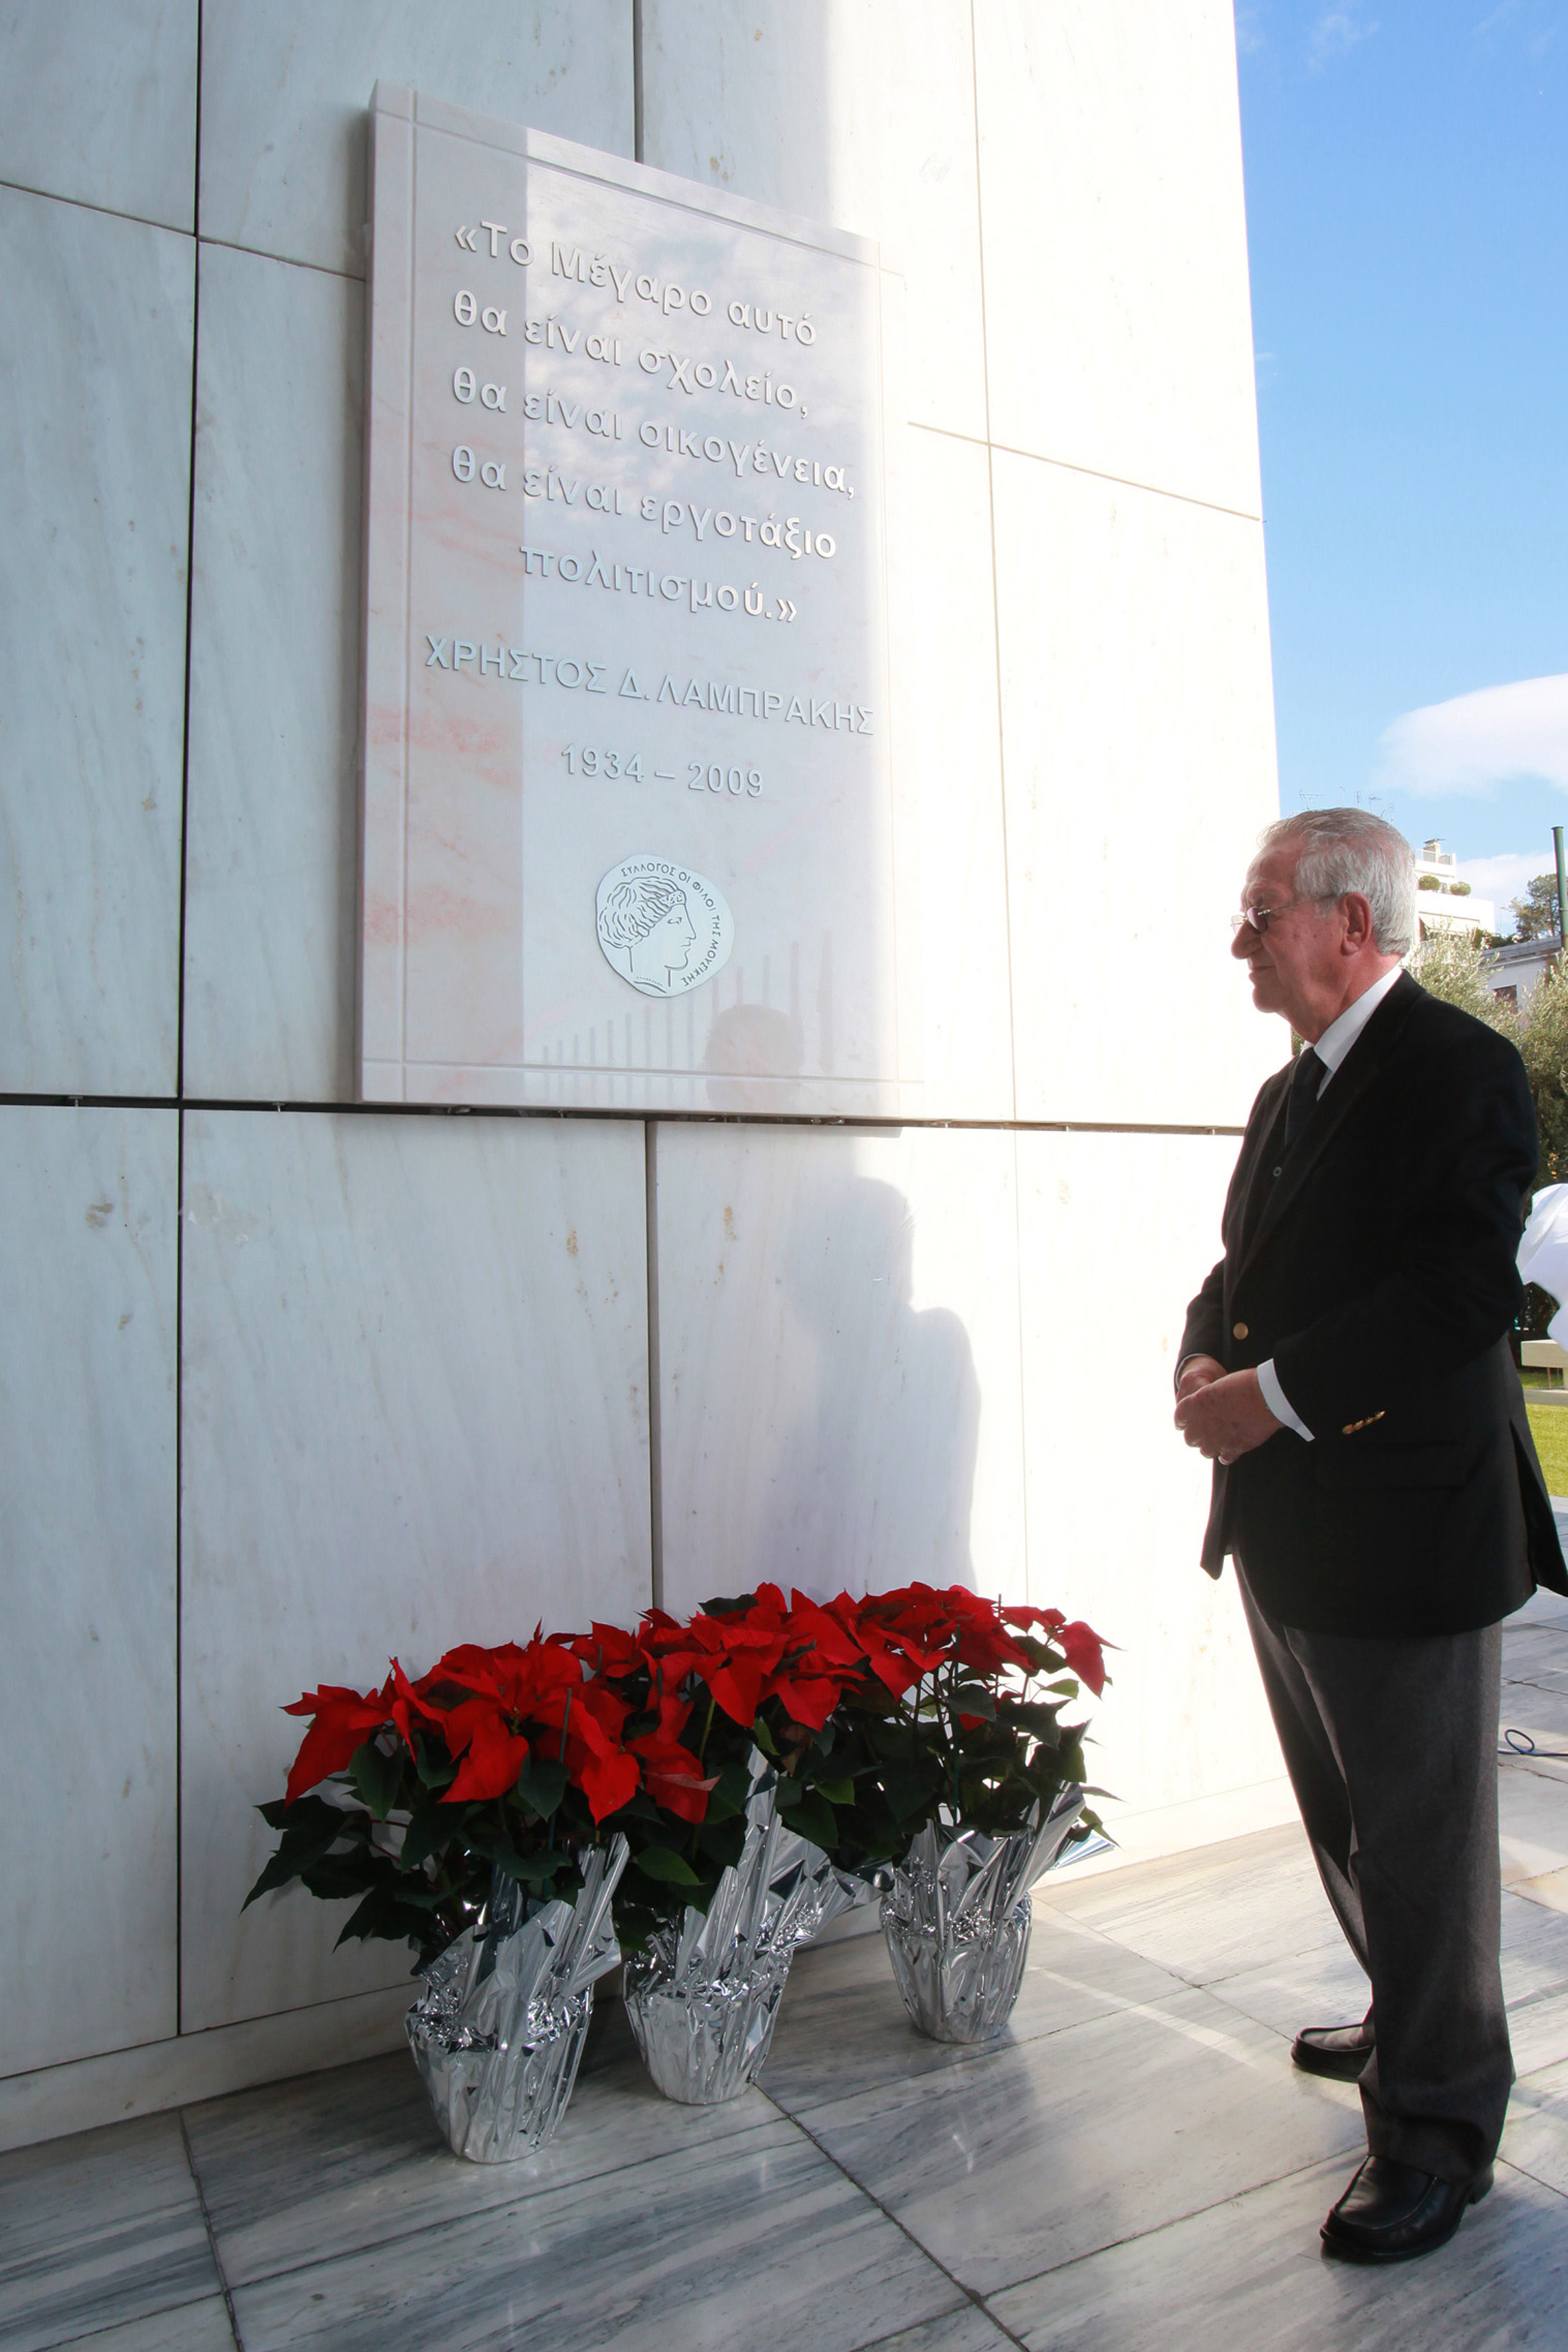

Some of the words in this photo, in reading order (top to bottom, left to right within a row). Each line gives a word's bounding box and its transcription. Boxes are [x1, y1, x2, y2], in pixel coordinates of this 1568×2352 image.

[455, 220, 535, 266] «Το
[550, 241, 712, 316] Μέγαρο
[728, 299, 817, 346] αυτό
[453, 289, 507, 336] θα
[524, 313, 622, 366] είναι
[638, 348, 809, 419] σχολείο,
[452, 366, 507, 413] θα
[524, 388, 623, 439] είναι
[638, 418, 854, 499] οικογένεια,
[451, 445, 507, 491] θα
[523, 465, 623, 514] είναι
[641, 493, 837, 560] εργοτάξιο
[520, 544, 798, 622] πολιτισμού.»
[426, 635, 607, 693] ΧΡΗΣΤΟΣ
[619, 667, 650, 700] Δ.
[657, 674, 874, 736] ΛΑΜΠΡΑΚΗΣ
[562, 744, 645, 783] 1934
[688, 761, 764, 797] 2009
[621, 862, 676, 877] ΣΥΛΛΟΓΟΣ
[678, 871, 691, 884] ΟΙ
[692, 882, 717, 911] ΦΙΛΟΙ
[712, 915, 722, 937] ΤΗΣ
[680, 939, 719, 987] ΜΟΥΣΙΚΗΣ
